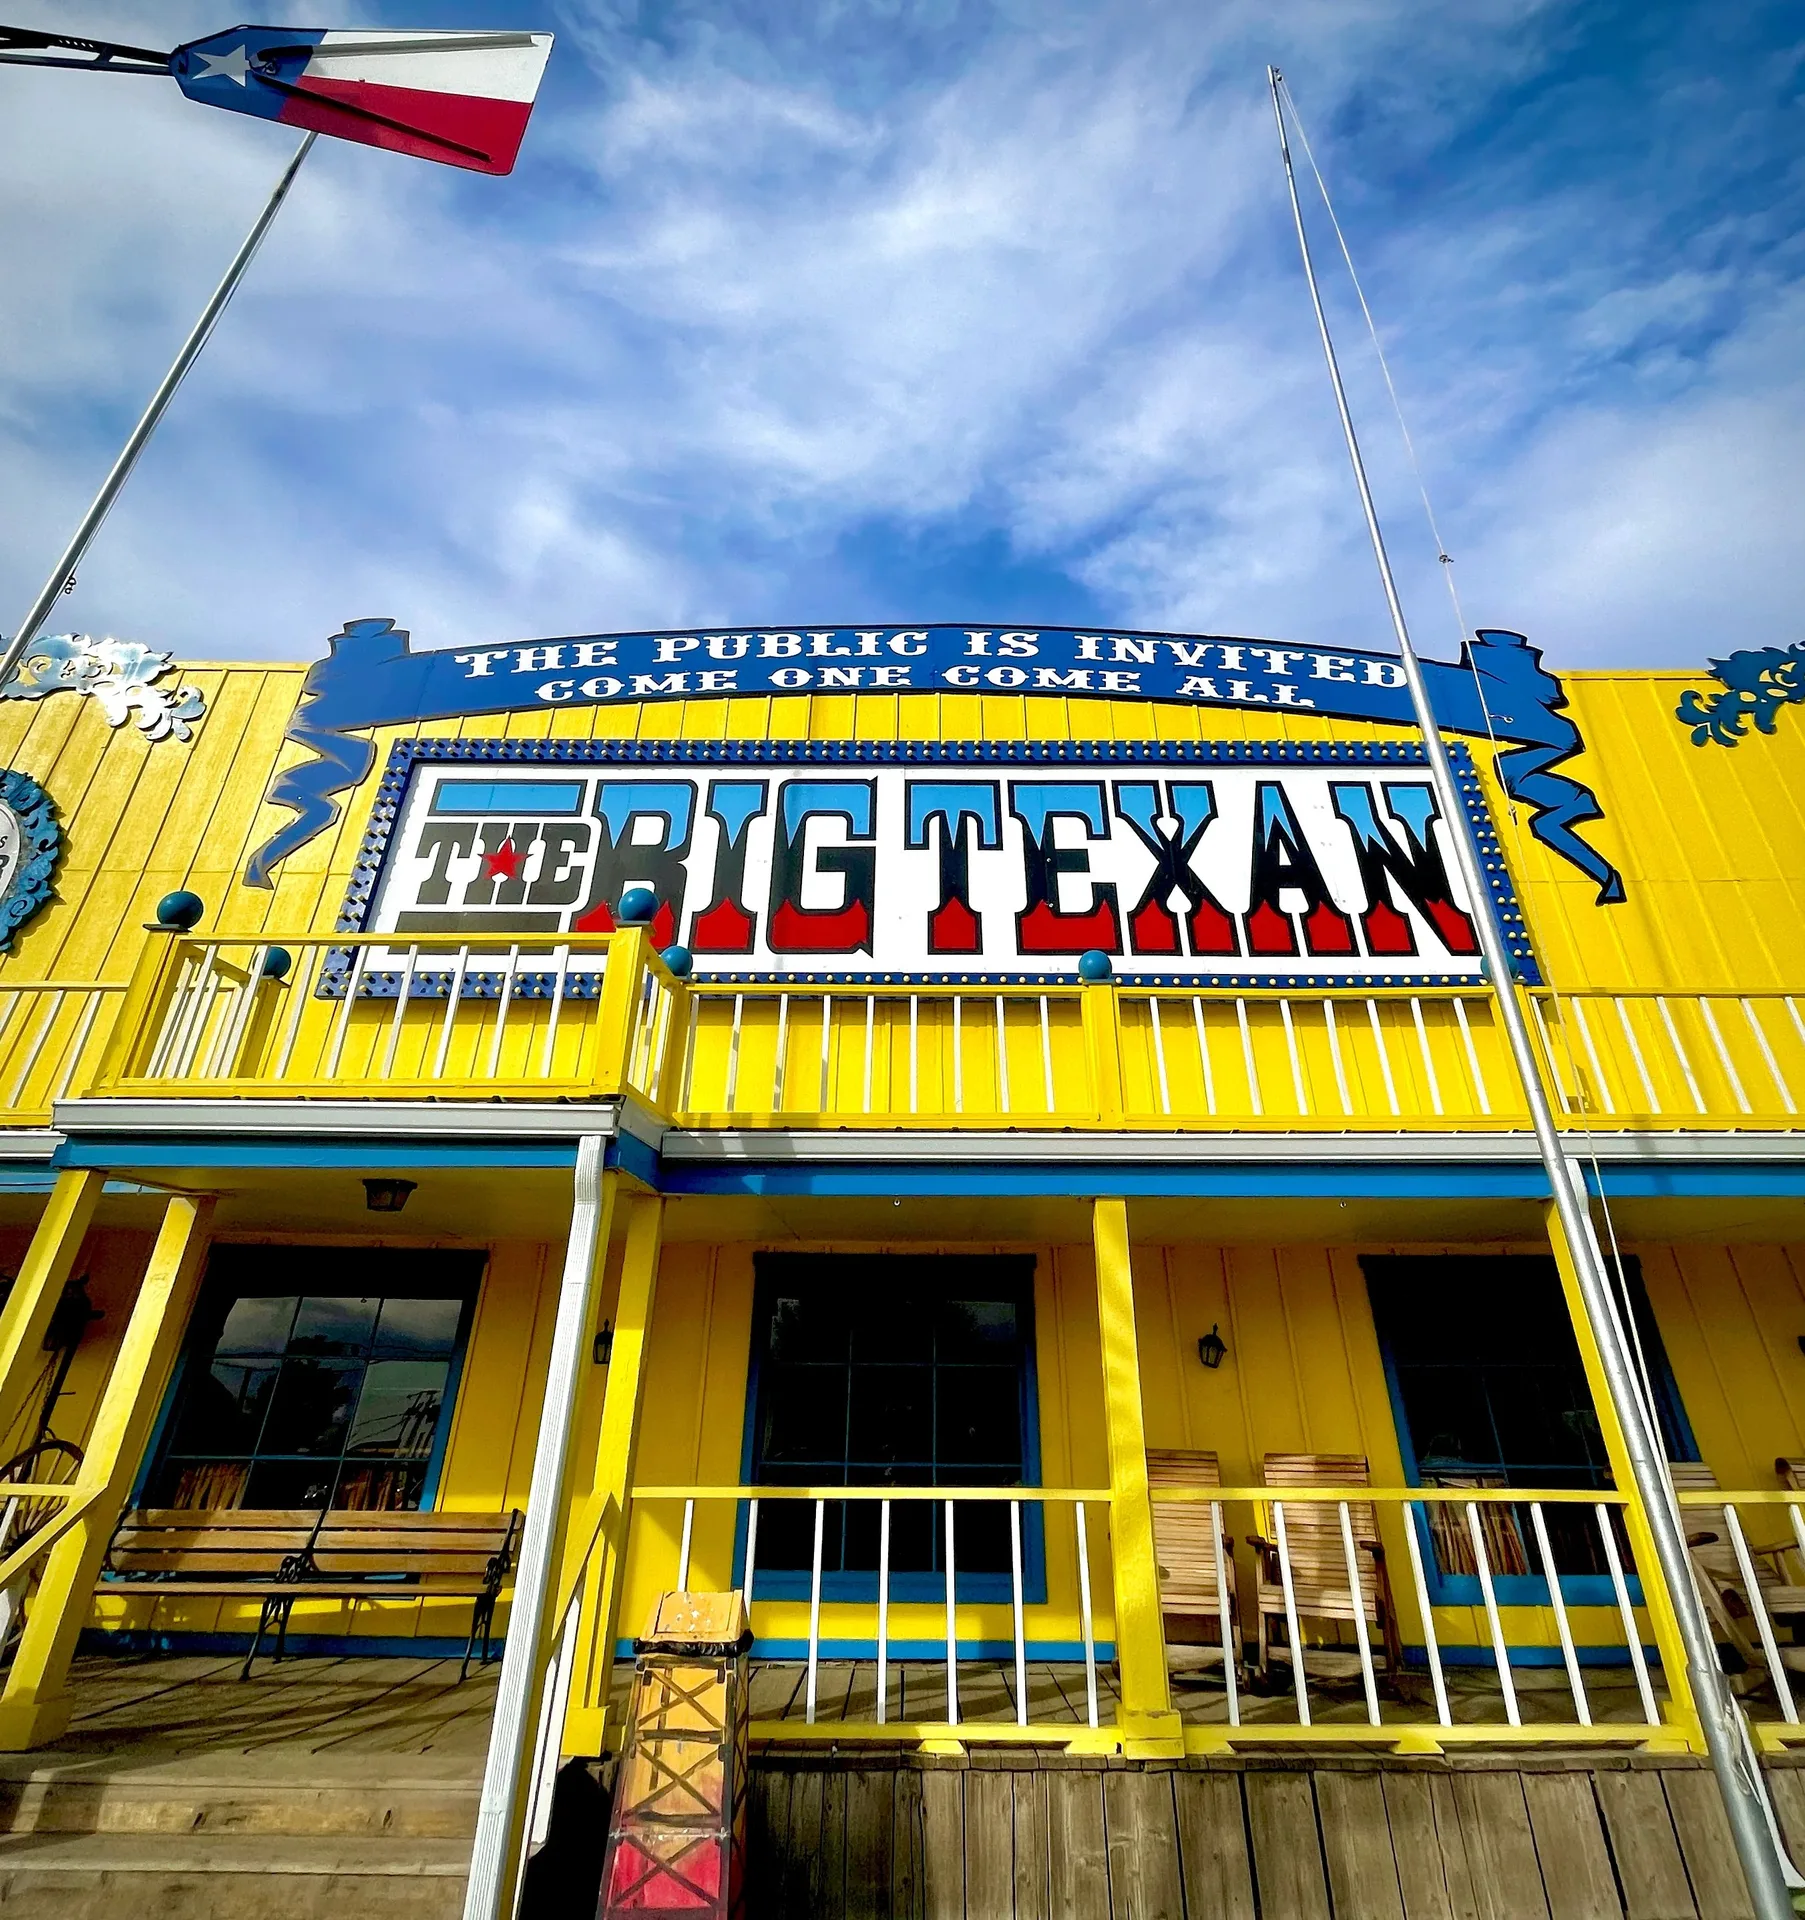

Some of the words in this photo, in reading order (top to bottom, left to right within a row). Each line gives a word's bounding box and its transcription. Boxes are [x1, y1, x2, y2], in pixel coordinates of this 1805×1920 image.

[455, 641, 619, 678] THE
[652, 631, 928, 662] PUBLIC
[963, 631, 1040, 656] IS
[1073, 635, 1408, 688] INVITED
[535, 668, 740, 702] COME
[767, 666, 912, 688] ONE
[940, 666, 1142, 692] COME
[1175, 677, 1317, 708] ALL
[415, 822, 591, 904] THE
[570, 776, 877, 958] BIG
[904, 780, 1483, 956] TEXAN
